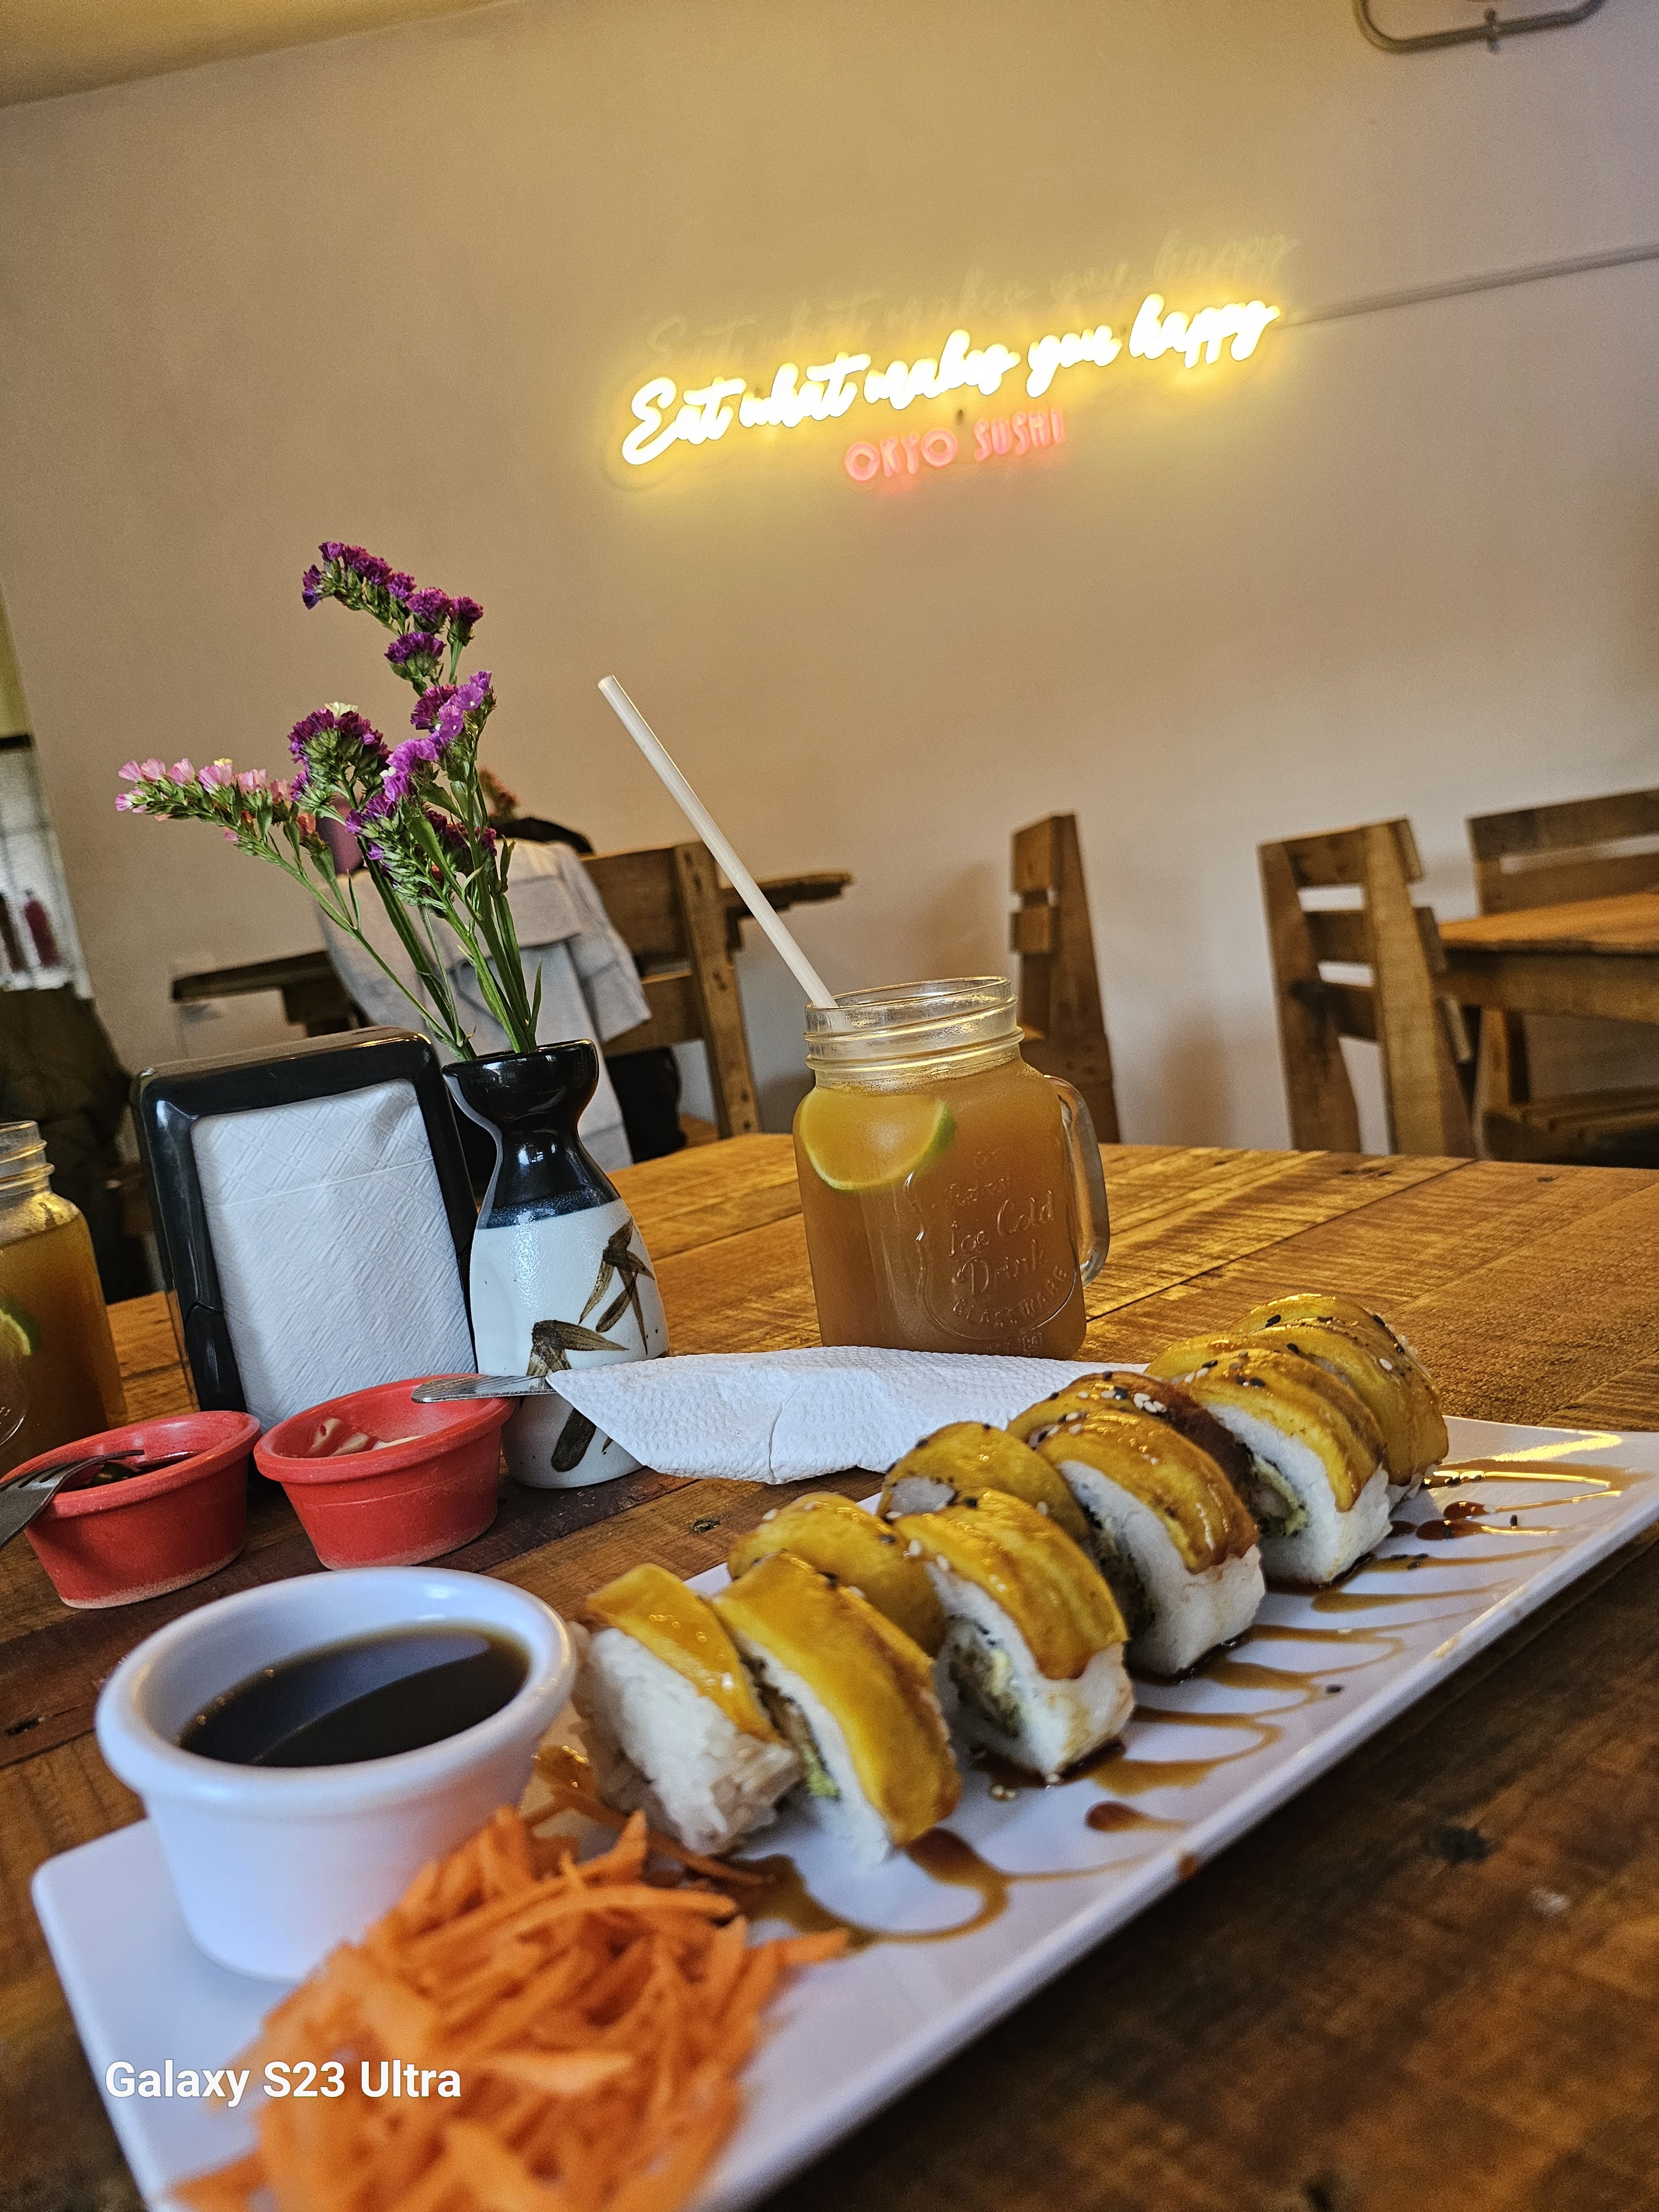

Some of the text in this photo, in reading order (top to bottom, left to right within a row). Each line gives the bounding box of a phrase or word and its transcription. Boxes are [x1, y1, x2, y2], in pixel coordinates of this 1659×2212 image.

[622, 294, 1281, 465] Eat what makes you happy
[974, 408, 1063, 462] SUSHI
[947, 1220, 989, 1258] Ice
[996, 1190, 1055, 1239] Cold
[952, 1239, 1046, 1296] Drink
